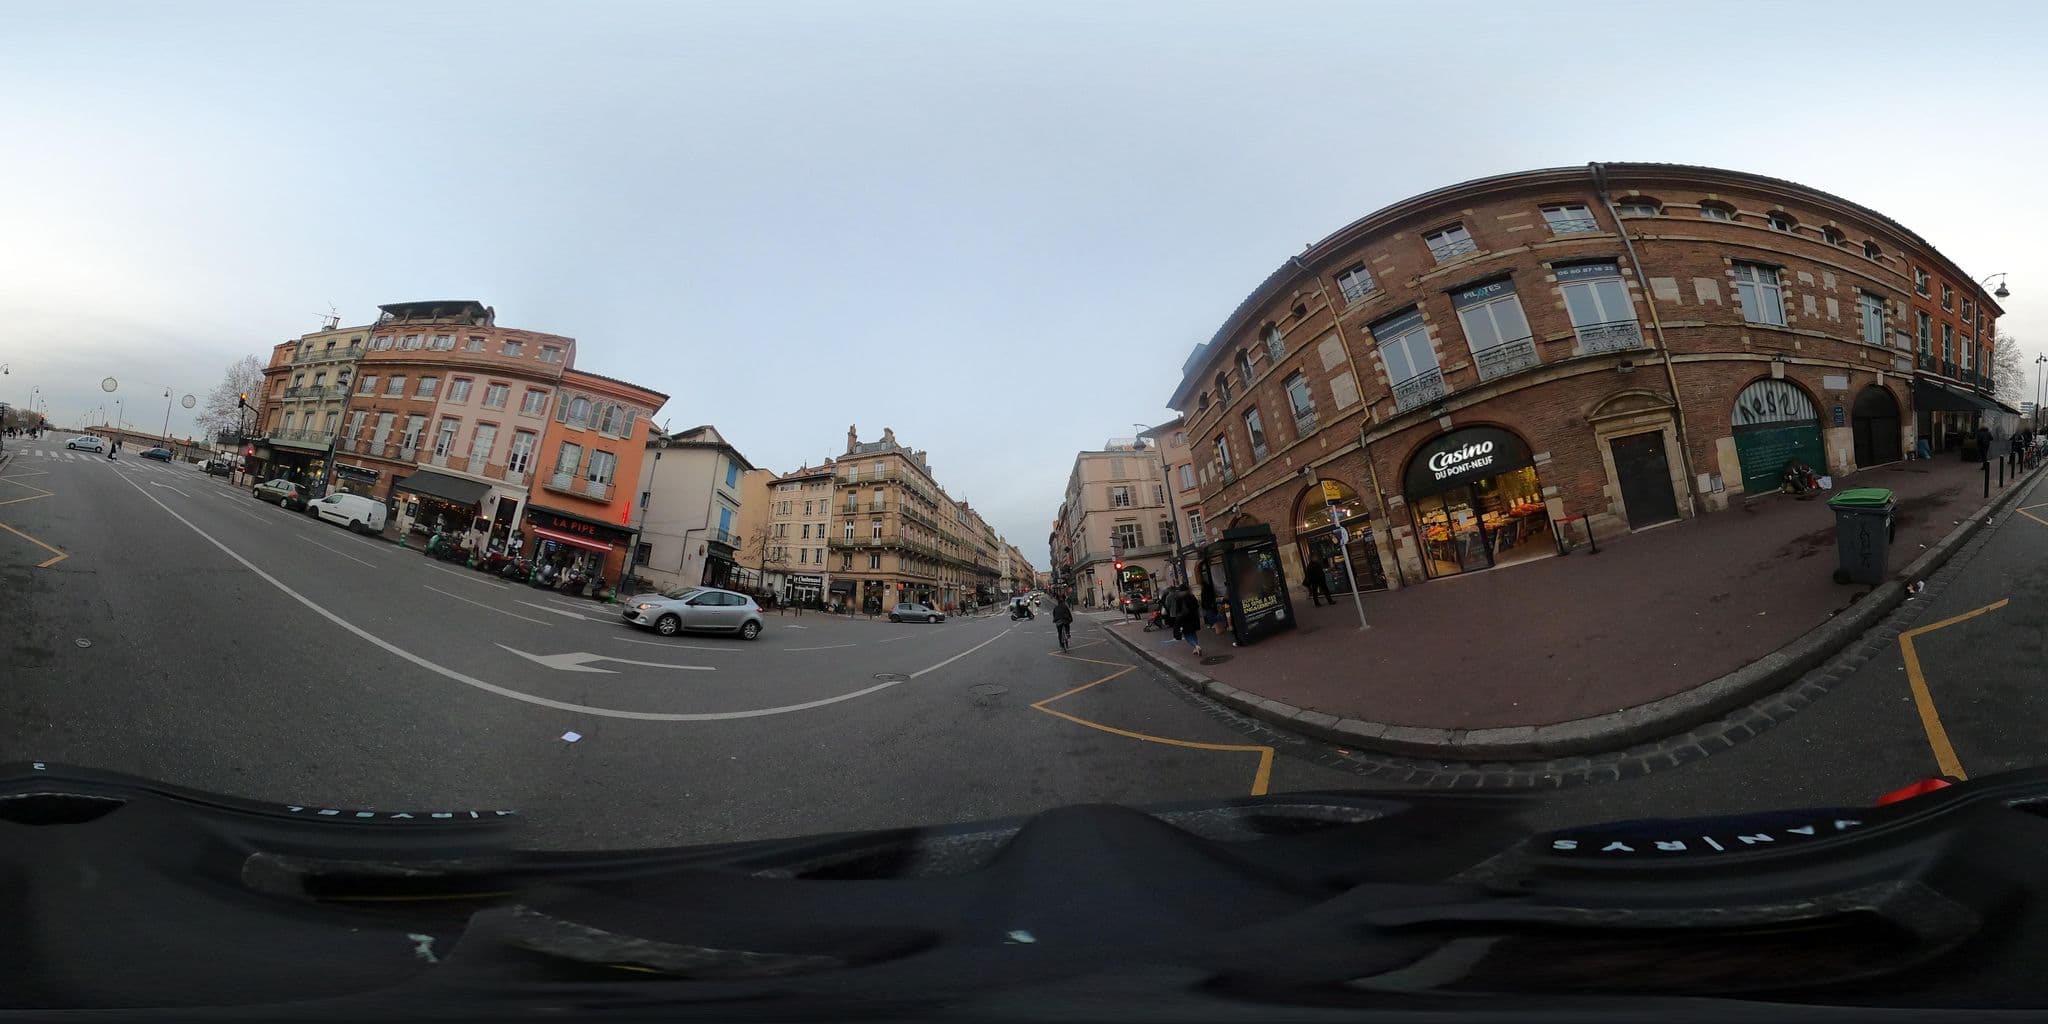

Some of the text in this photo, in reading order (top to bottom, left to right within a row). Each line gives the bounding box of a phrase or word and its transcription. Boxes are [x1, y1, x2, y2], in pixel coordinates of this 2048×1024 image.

[1428, 440, 1494, 472] Casino
[1434, 455, 1494, 480] DU PONT-NEUF
[553, 518, 597, 535] LA PIPE
